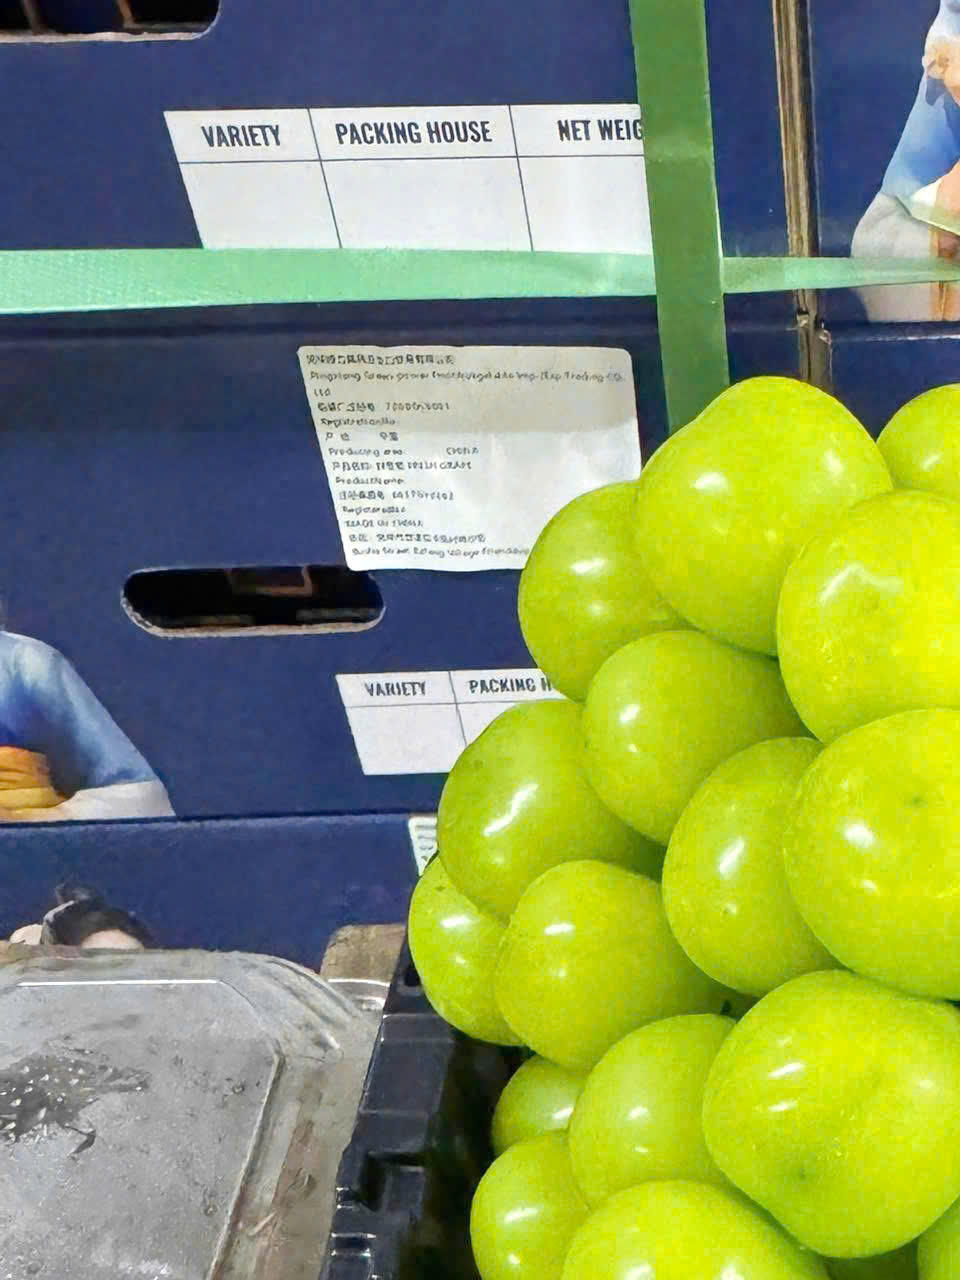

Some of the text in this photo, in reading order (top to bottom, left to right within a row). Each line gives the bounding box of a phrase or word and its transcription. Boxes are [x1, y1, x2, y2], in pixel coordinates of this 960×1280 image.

[201, 124, 281, 148] VARIETY
[335, 119, 493, 145] PACKING HOUSE
[558, 118, 592, 142] NET
[364, 680, 427, 697] VARIETY
[468, 677, 536, 694] PACKING
